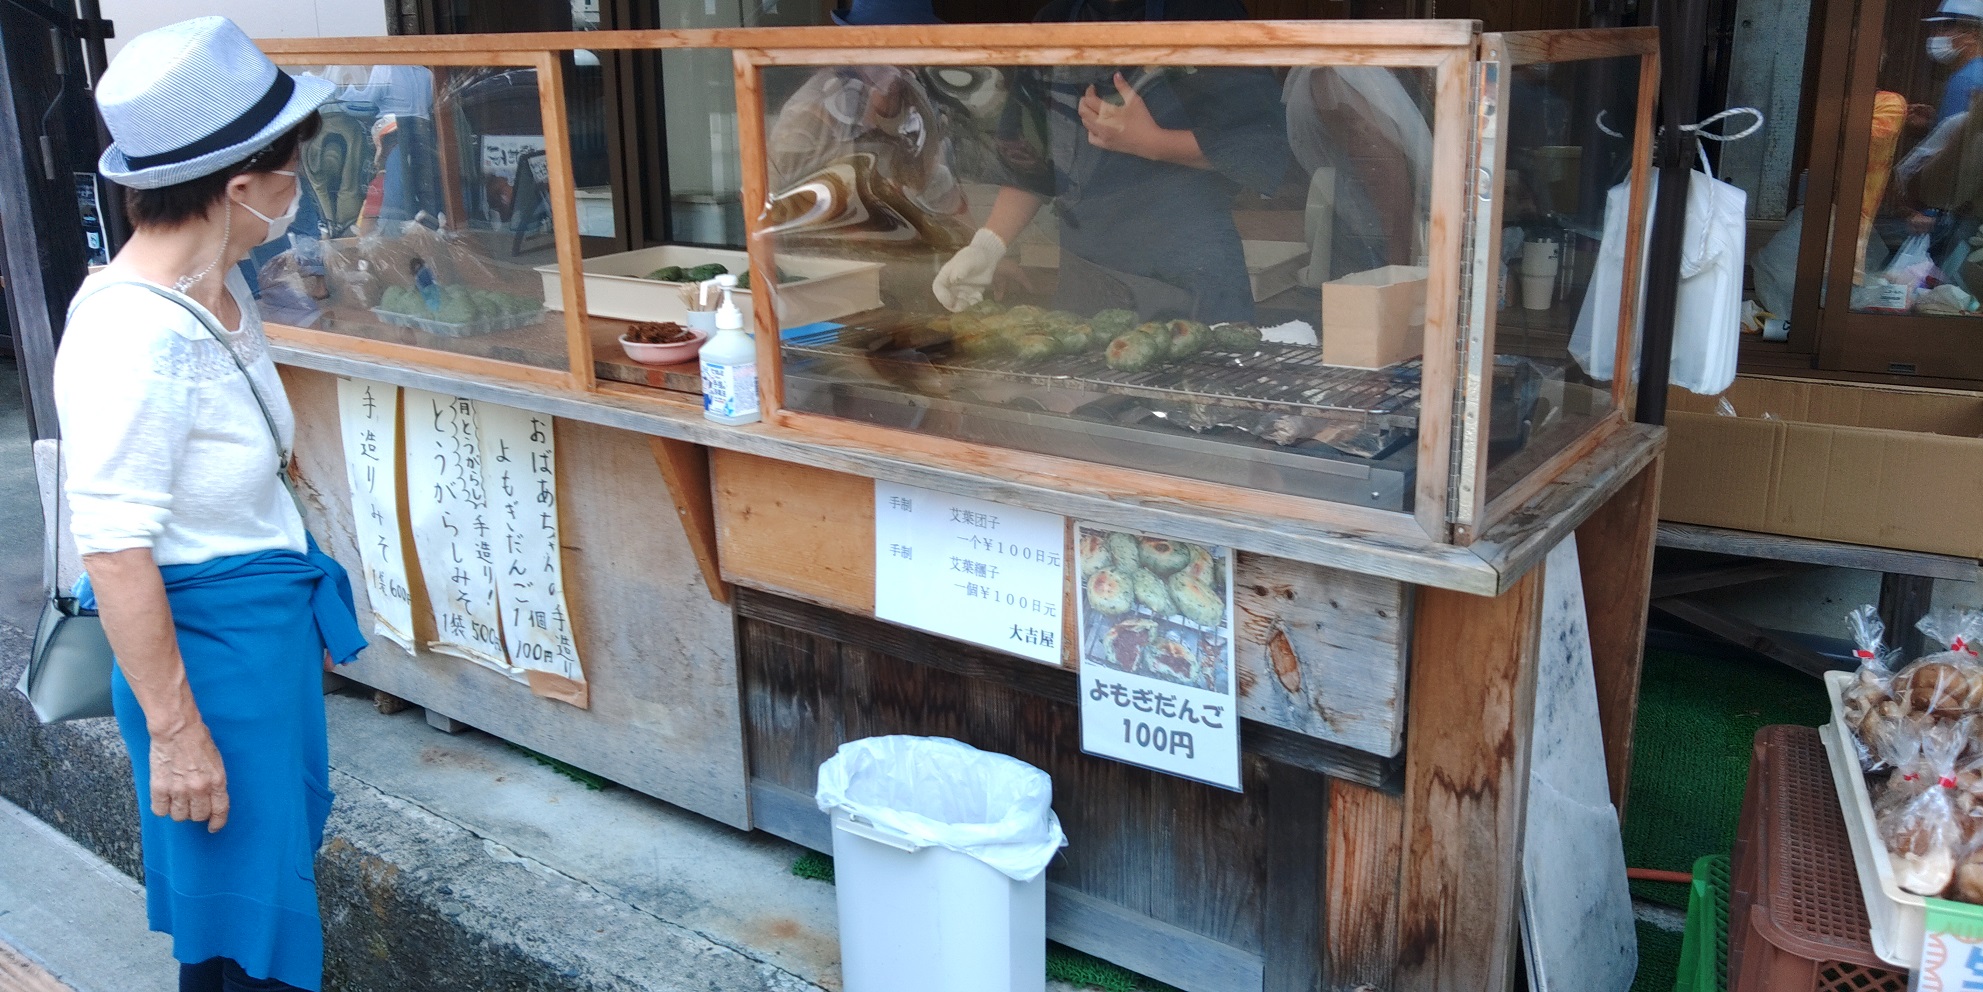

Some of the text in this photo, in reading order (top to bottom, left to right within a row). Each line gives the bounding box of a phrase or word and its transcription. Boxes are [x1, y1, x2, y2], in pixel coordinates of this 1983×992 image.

[360, 385, 389, 564] 手造りみそ
[496, 438, 533, 603] よもぎだんご
[1008, 623, 1055, 649] 大吉屋
[1089, 678, 1225, 729] よもぎだんご
[1123, 717, 1195, 760] 100円
